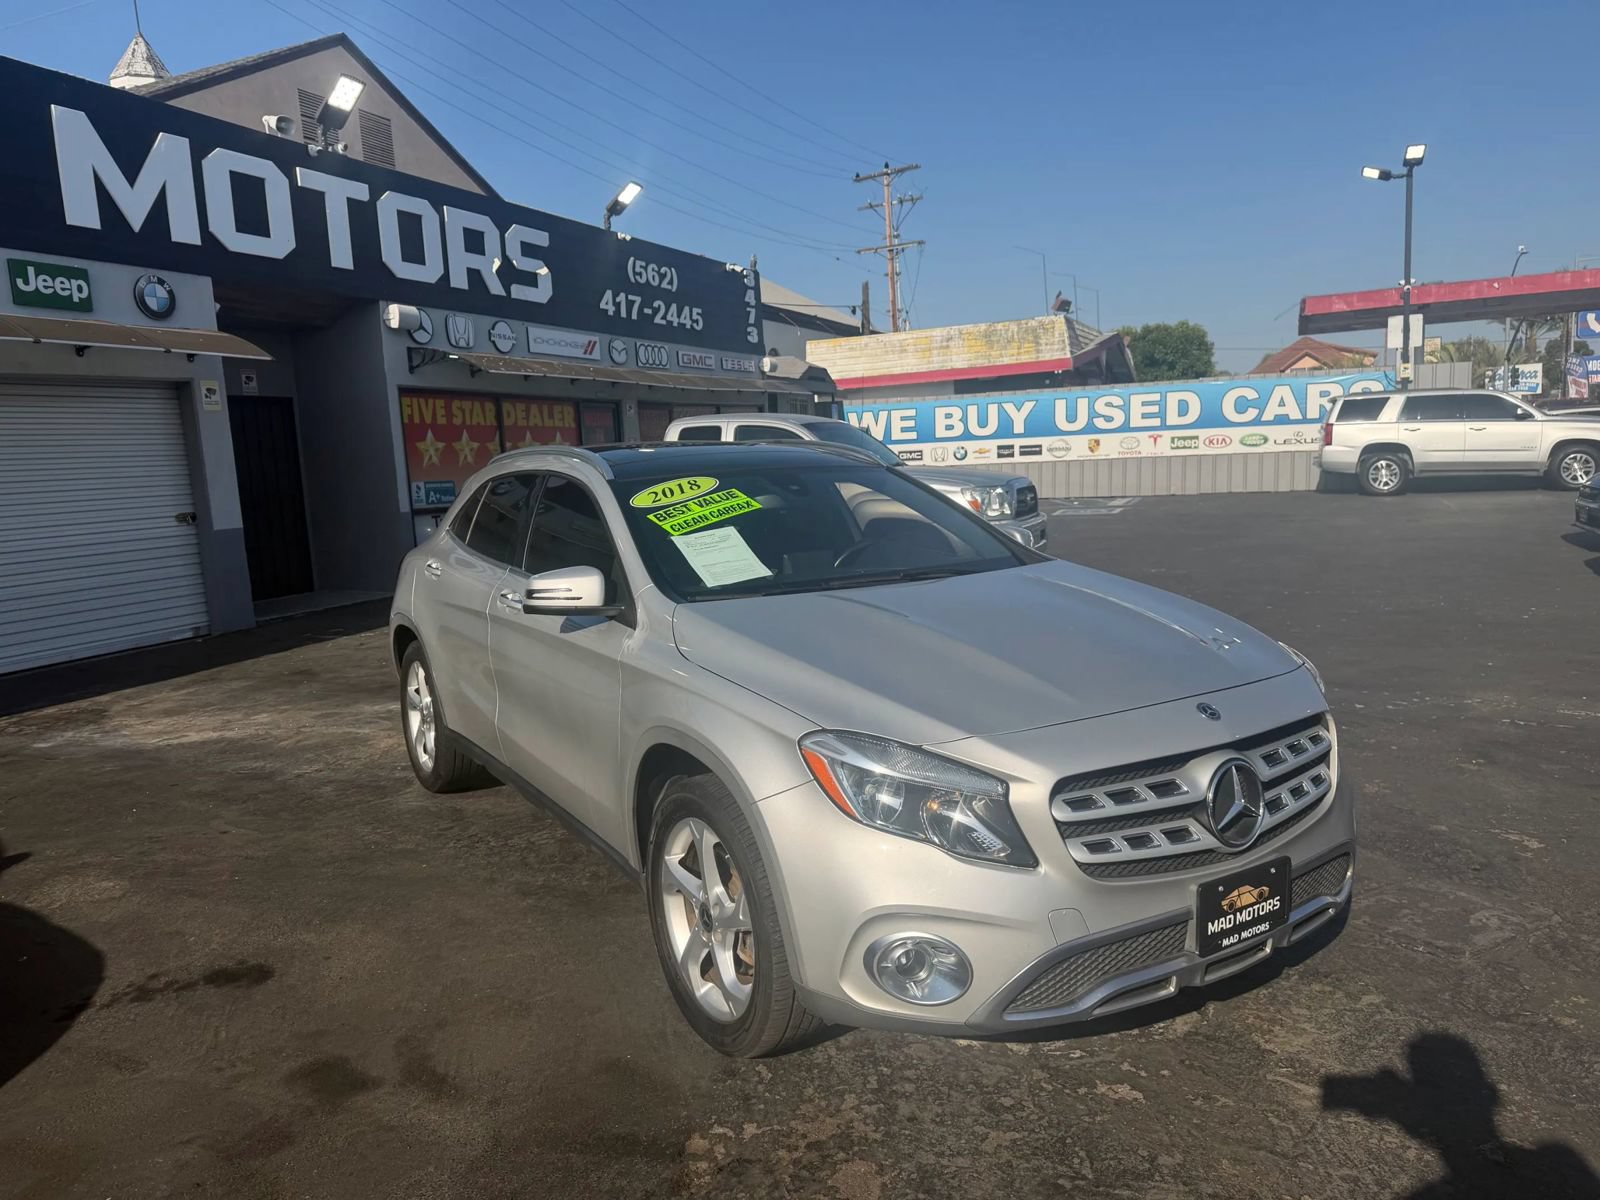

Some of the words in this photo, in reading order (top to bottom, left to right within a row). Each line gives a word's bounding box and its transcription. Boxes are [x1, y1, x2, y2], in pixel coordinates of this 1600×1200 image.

[51, 104, 554, 304] MOTORS
[16, 266, 89, 302] Jeep
[627, 257, 678, 292] (562)
[600, 289, 703, 330] 417-2445
[682, 353, 712, 366] GMC
[402, 396, 447, 425] FIVE
[452, 399, 498, 426] STAR
[504, 401, 576, 428] DEALER
[847, 408, 918, 441] WE
[934, 400, 1037, 438] BUY
[1054, 391, 1202, 431] USED
[899, 452, 922, 460] GMC
[1171, 437, 1199, 449] Jeep
[1208, 438, 1227, 446] KIA
[647, 479, 701, 505] 2018
[653, 503, 692, 523] BEST
[694, 490, 740, 511] VALUE
[670, 513, 708, 533] CLEAN
[709, 500, 753, 519] CARFAX
[1208, 914, 1234, 936] MAD
[1236, 896, 1281, 925] MOTORS
[1222, 934, 1240, 948] MAD
[1240, 922, 1270, 940] MOTORS
